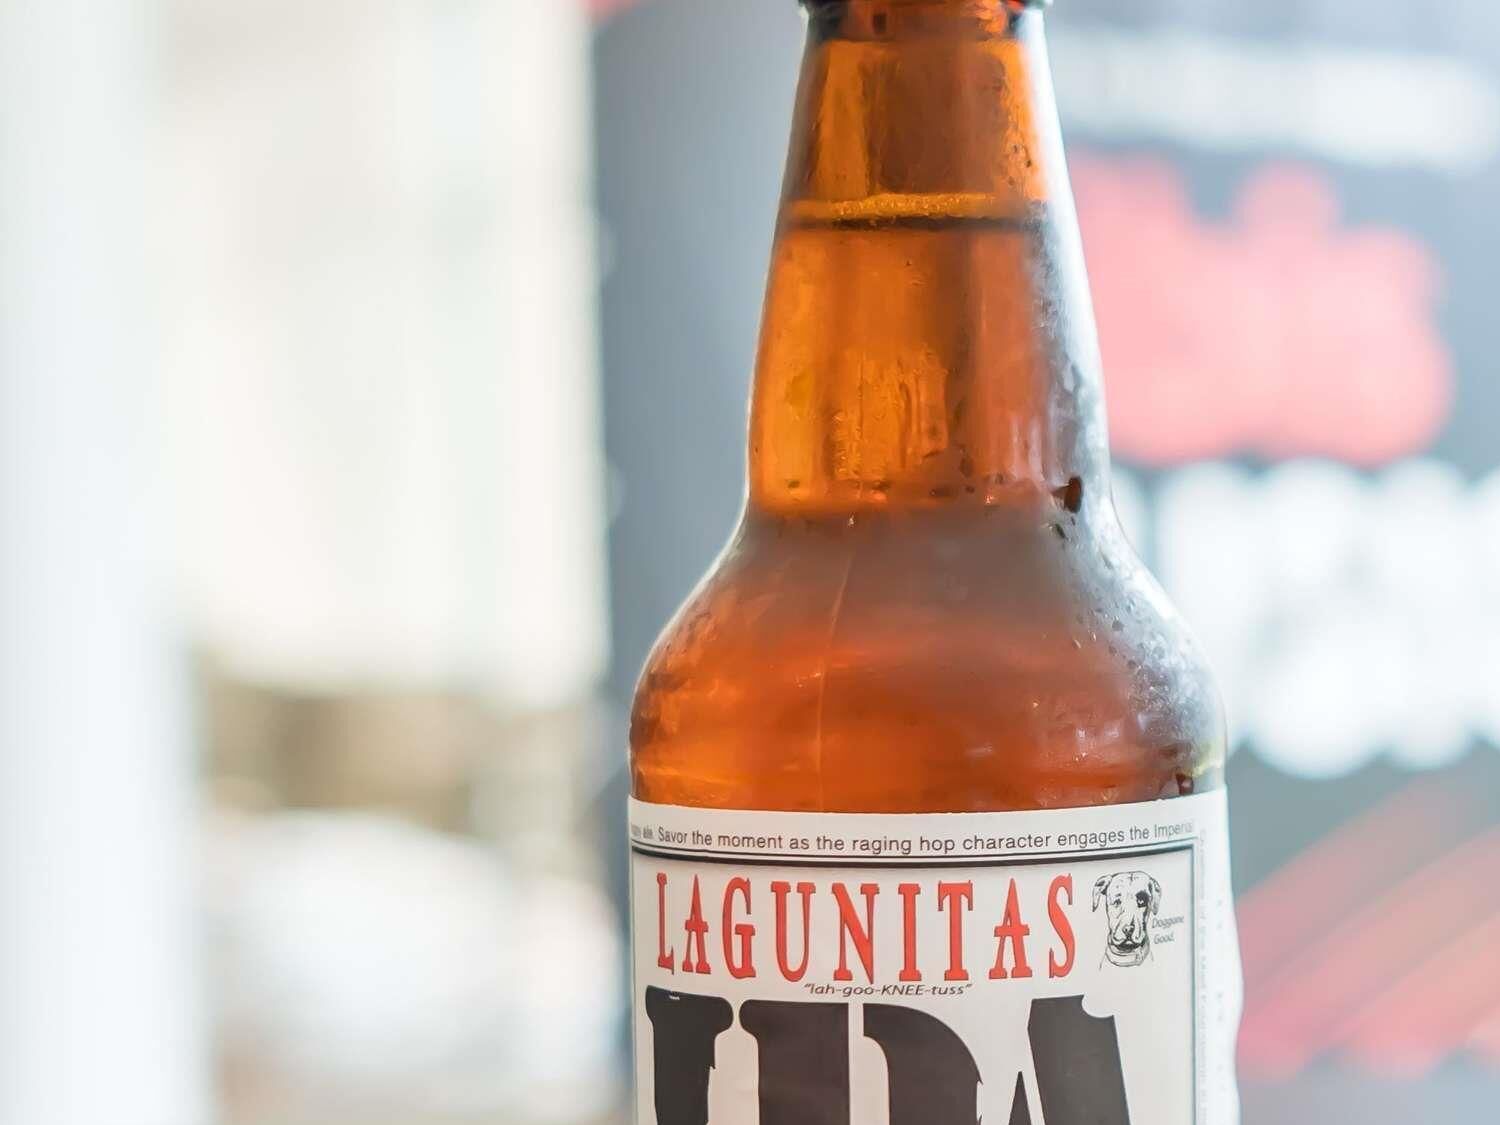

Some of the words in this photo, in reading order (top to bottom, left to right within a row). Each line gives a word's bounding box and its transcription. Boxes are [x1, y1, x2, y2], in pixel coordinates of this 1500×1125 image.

[658, 826, 687, 843] Savor
[692, 830, 712, 845] the
[718, 832, 782, 849] moment
[789, 837, 809, 850] as
[816, 835, 845, 850] the
[852, 835, 911, 855] raging
[920, 836, 955, 854] hop
[963, 834, 1051, 850] character
[1057, 830, 1125, 848] engages
[1129, 825, 1149, 840] the
[656, 872, 1076, 984] LAGUNITAS
